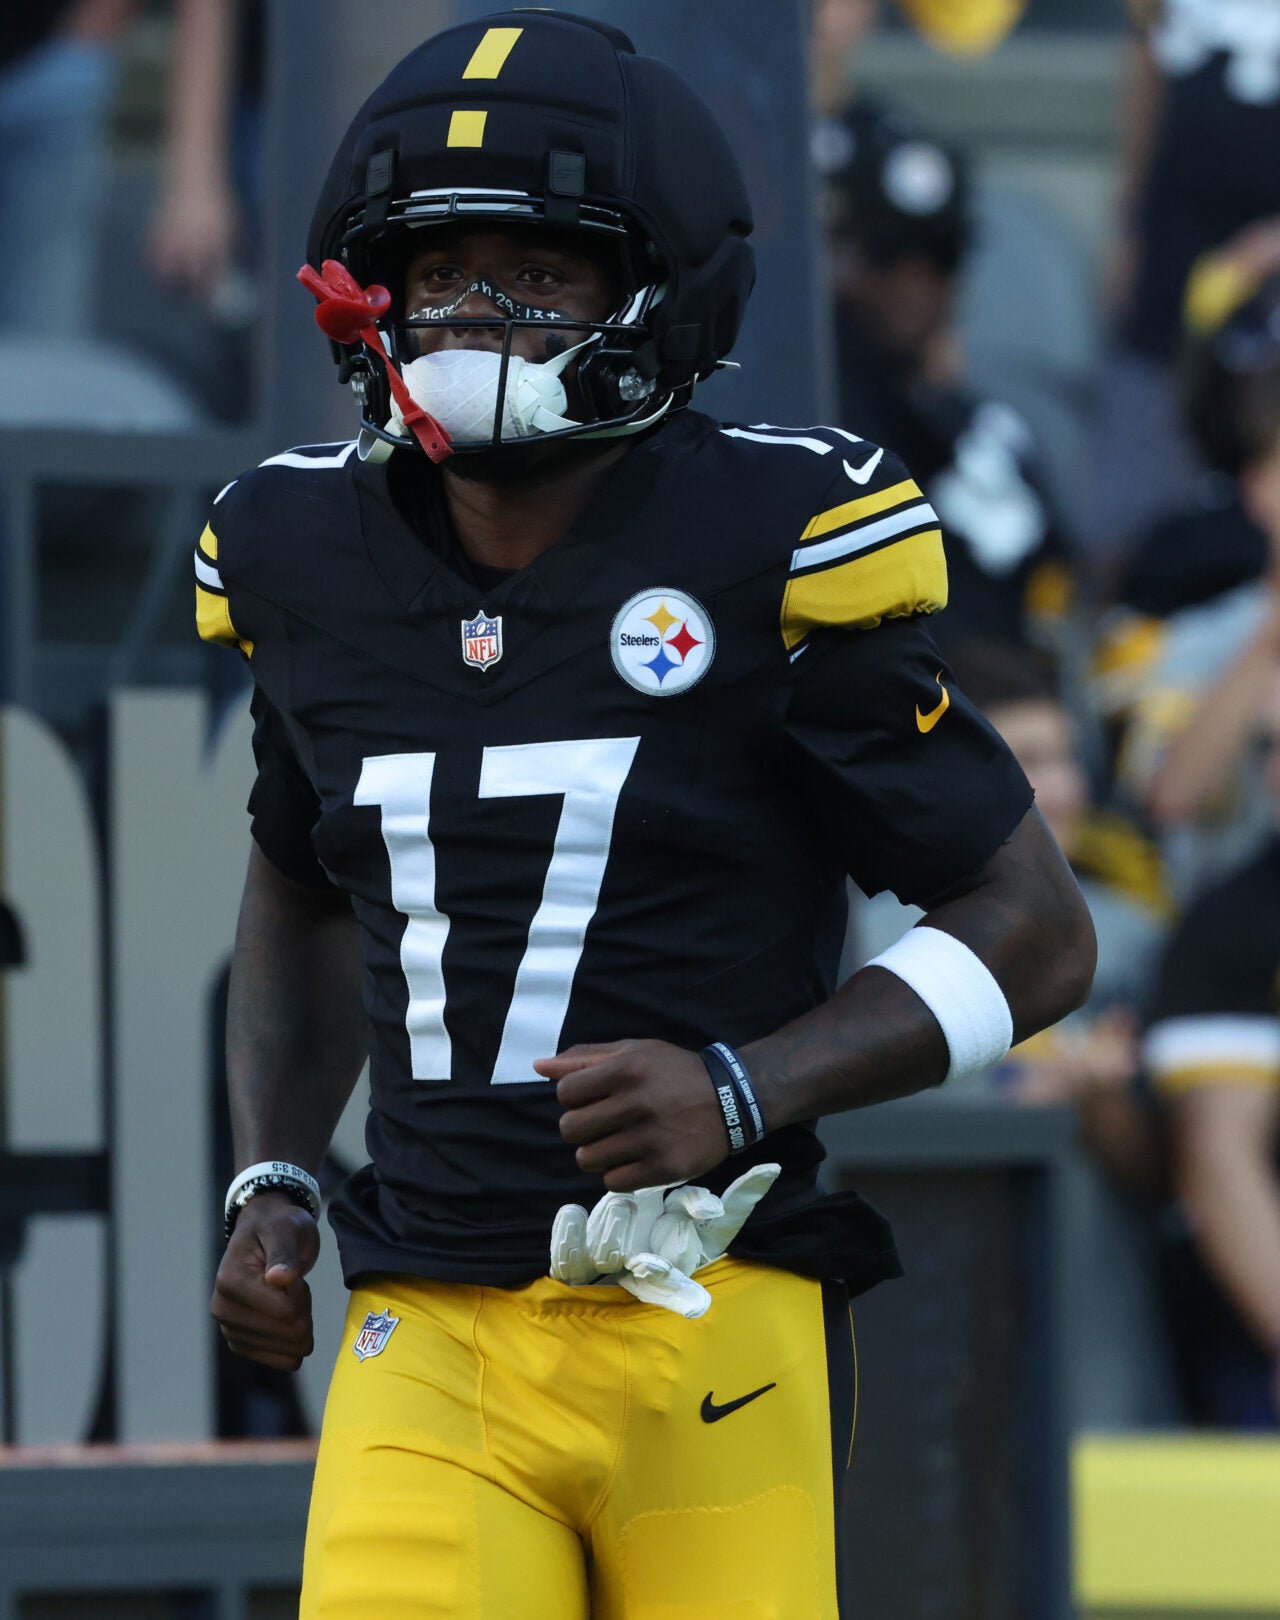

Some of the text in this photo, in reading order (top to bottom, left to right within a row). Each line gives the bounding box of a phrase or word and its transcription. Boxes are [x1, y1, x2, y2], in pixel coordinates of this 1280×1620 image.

[467, 637, 496, 661] NFL
[620, 633, 660, 646] Steelers
[353, 736, 641, 1084] 17
[730, 1062, 745, 1080] WHO
[739, 1079, 756, 1104] CHRIST
[717, 1085, 746, 1149] GODS CHOSEN
[272, 1162, 289, 1173] 3:5
[357, 1330, 381, 1351] NFL
